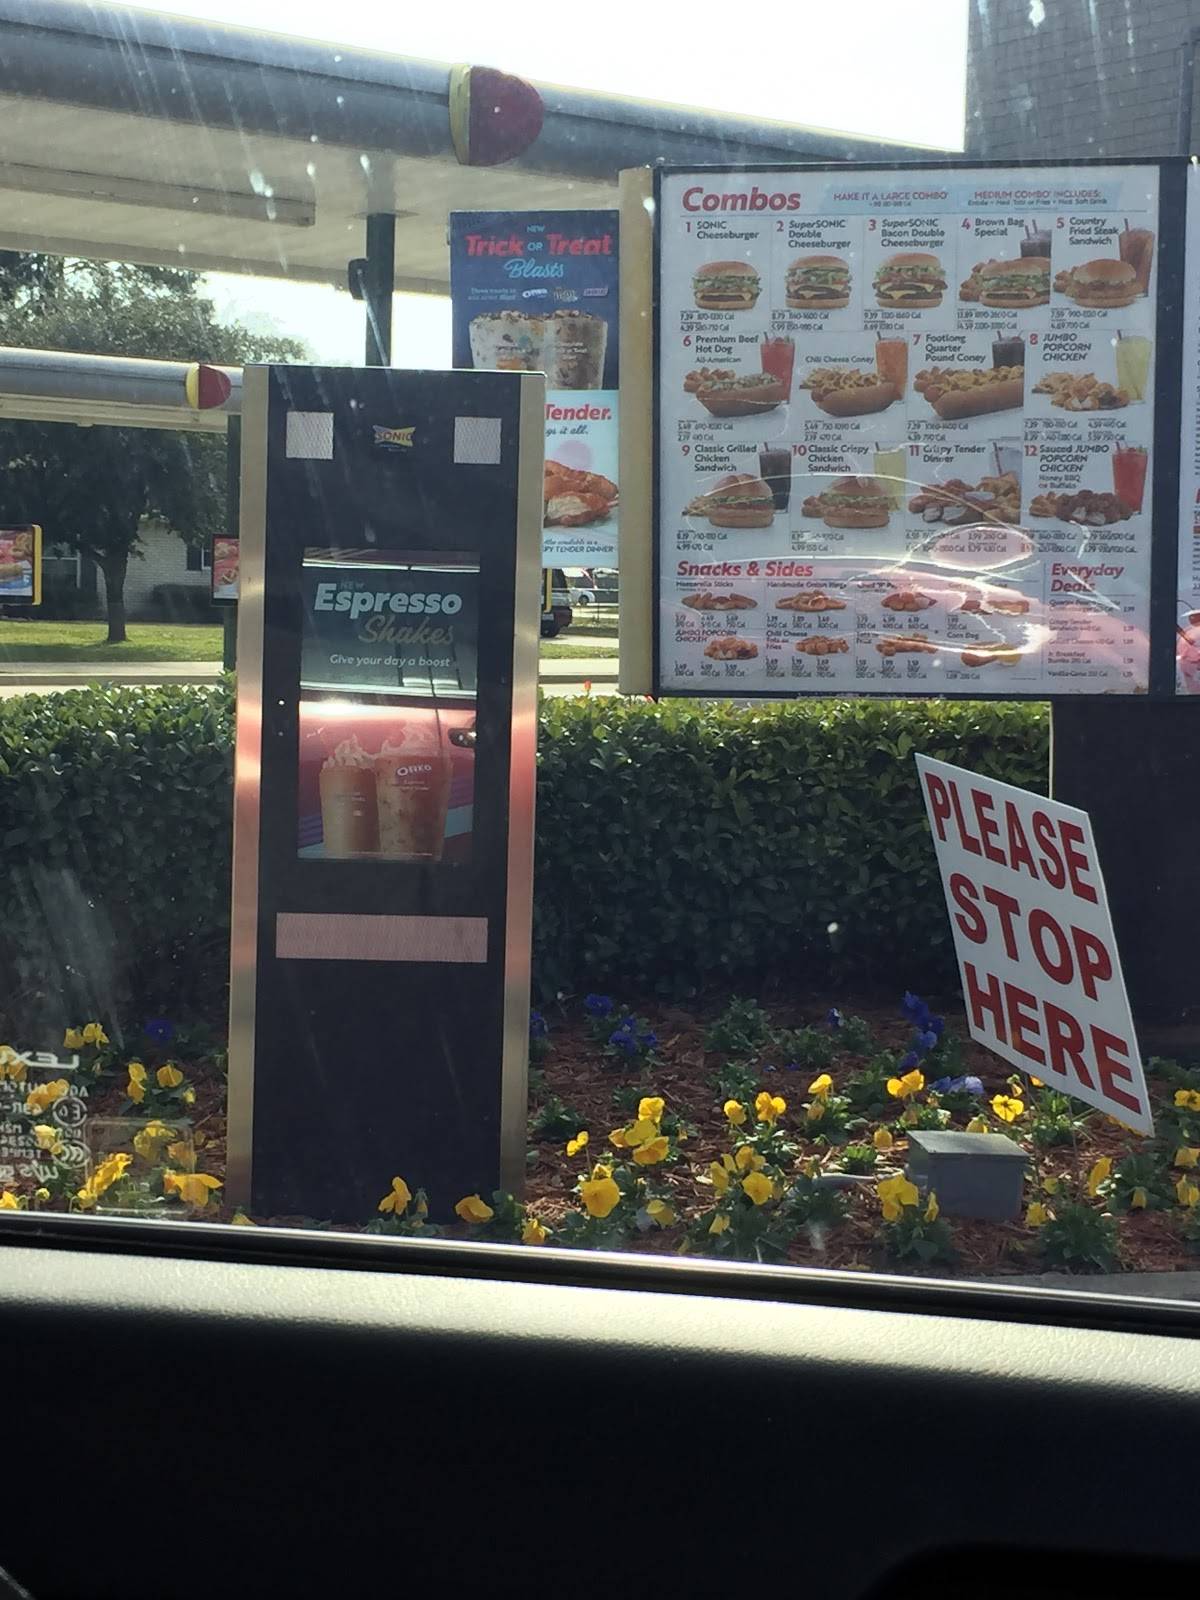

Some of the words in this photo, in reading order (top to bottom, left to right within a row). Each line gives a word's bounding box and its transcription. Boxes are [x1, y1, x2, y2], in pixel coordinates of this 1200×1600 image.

[683, 187, 801, 211] Combos
[863, 192, 869, 200] IT
[881, 192, 910, 200] LARGE
[975, 191, 1012, 199] MEDIUM
[686, 222, 691, 232] 1
[697, 221, 727, 230] SONIC
[777, 221, 784, 232] 2
[789, 220, 846, 229] SuperSONIC
[868, 219, 877, 231] 3
[881, 218, 939, 229] SuperSONIC
[961, 218, 971, 229] 4
[975, 218, 1005, 227] Brown
[1008, 218, 1024, 229] Bag
[1057, 218, 1065, 228] 5
[1069, 217, 1106, 227] Country
[697, 231, 759, 240] Cheeseburger
[789, 230, 822, 238] Double
[881, 229, 909, 238] Bacon
[916, 228, 945, 238] Double
[975, 227, 1008, 236] Special
[1069, 227, 1092, 235] Fried
[1094, 227, 1119, 235] Steak
[465, 234, 525, 256] Trick
[527, 242, 543, 251] OR
[547, 233, 613, 256] Treat
[788, 240, 851, 249] Cheeseburger
[881, 238, 944, 249] Cheeseburger
[1069, 237, 1112, 245] Sandwich
[504, 258, 564, 278] Blasts
[683, 336, 692, 347] 6
[696, 335, 736, 344] Premium
[739, 335, 759, 343] Beef
[913, 334, 921, 345] 7
[926, 334, 966, 344] Footlong
[1030, 334, 1039, 345] 8
[1043, 333, 1077, 342] JUMBO
[696, 345, 712, 353] Hot
[714, 345, 732, 354] Dog
[925, 344, 961, 353] Quarter
[1043, 343, 1092, 351] POPCORN
[851, 356, 874, 365] Coney
[925, 354, 955, 362] Pound
[957, 354, 986, 363] Coney
[1042, 353, 1085, 361] CHICKEN
[560, 426, 569, 434] it
[570, 425, 589, 434] all.
[375, 430, 412, 441] SONIC
[682, 446, 690, 456] 9
[695, 445, 725, 453] Classic
[727, 445, 757, 453] Grilled
[792, 446, 807, 456] 10
[808, 445, 838, 453] Classic
[840, 445, 869, 455] Crispy
[909, 446, 920, 456] 11
[955, 445, 986, 453] Tender
[1024, 445, 1038, 456] 12
[1040, 444, 1073, 453] Sauced
[1075, 444, 1110, 453] JUMBO
[695, 454, 730, 462] Chicken
[808, 454, 844, 462] Chicken
[1040, 454, 1087, 463] POPCORN
[694, 464, 737, 472] Sandwich
[808, 464, 851, 472] Sandwich
[1040, 464, 1084, 472] CHICKEN
[1039, 475, 1062, 483] Honey
[1064, 474, 1081, 482] BBQ
[677, 561, 741, 576] Snacks
[747, 561, 759, 576] &
[765, 561, 813, 577] Sides
[1052, 563, 1124, 578] Everyday
[314, 583, 462, 619] Espresso
[358, 615, 454, 644] Shakes
[968, 632, 979, 640] Dog
[330, 654, 354, 665] Give
[356, 655, 381, 667] your
[384, 655, 406, 667] day
[408, 658, 416, 666] a
[419, 656, 450, 668] boost
[925, 772, 1098, 904] PLEASE
[950, 873, 1112, 1001] STOP
[964, 961, 1142, 1114] HERE
